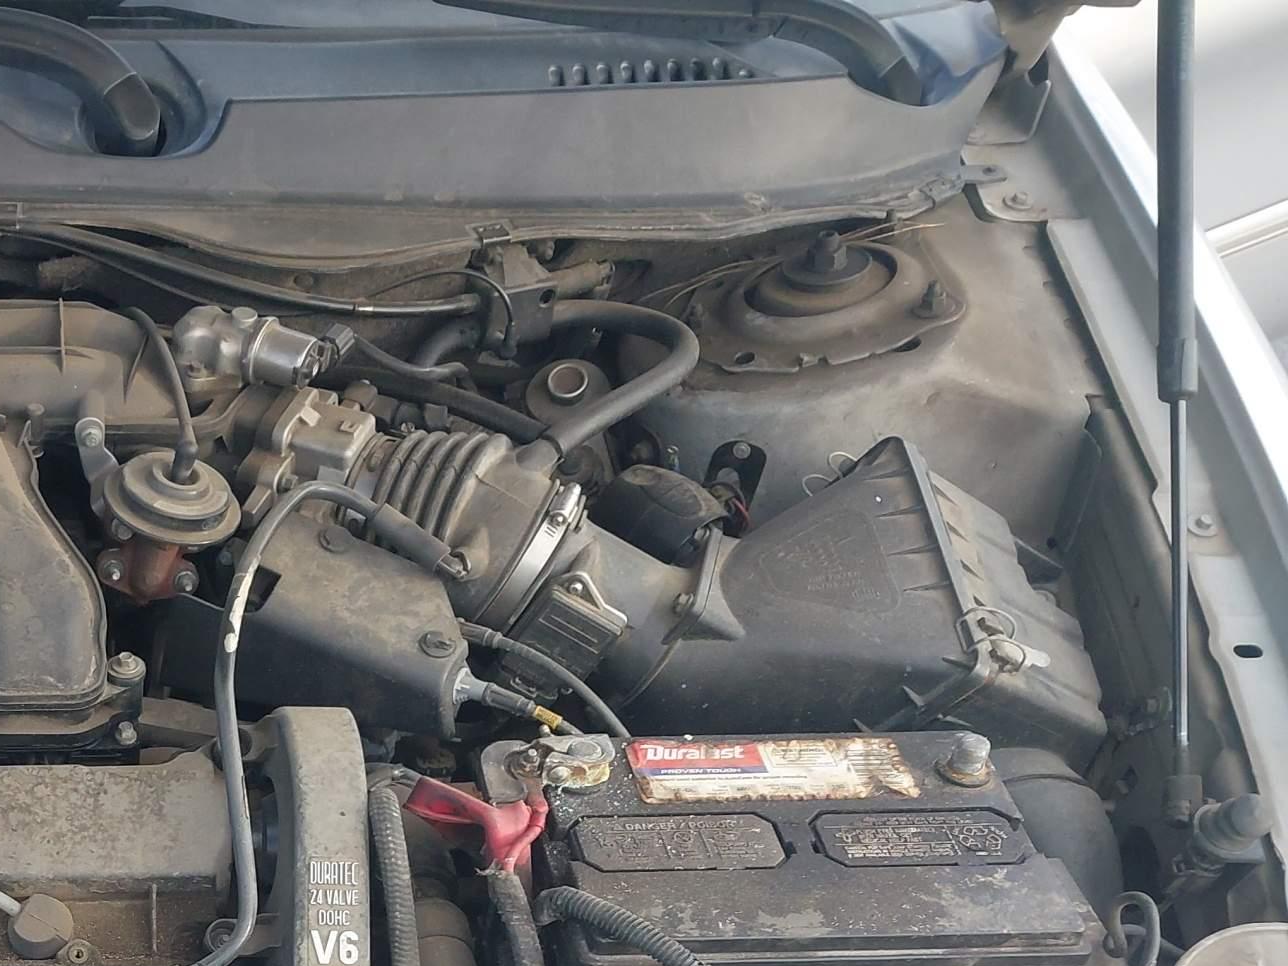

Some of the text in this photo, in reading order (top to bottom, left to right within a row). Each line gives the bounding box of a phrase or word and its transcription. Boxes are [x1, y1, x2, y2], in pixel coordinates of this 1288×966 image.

[310, 861, 360, 885] DURATEC
[310, 889, 360, 906] 24 VALVE
[318, 909, 351, 926] DOHC
[310, 929, 359, 965] V6
